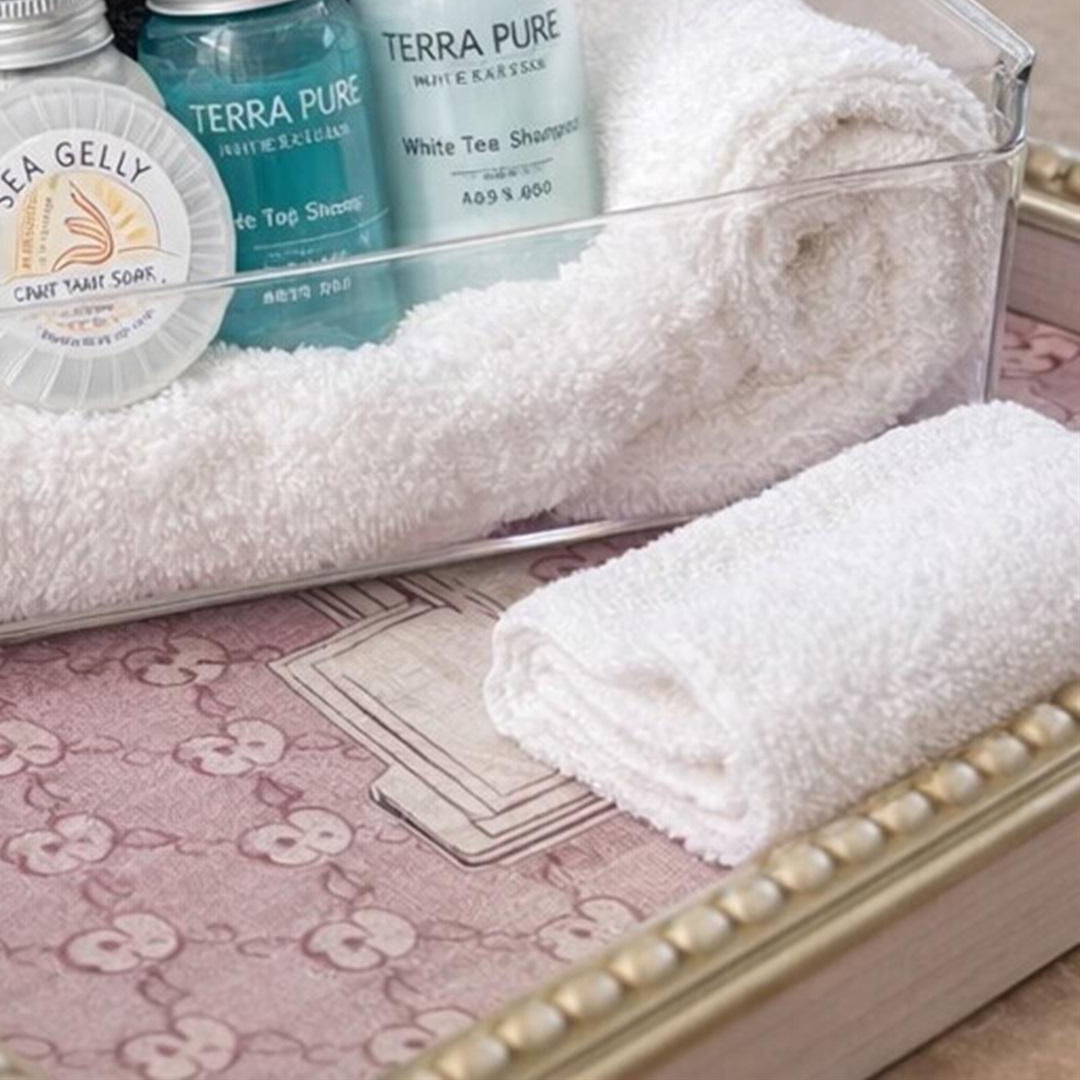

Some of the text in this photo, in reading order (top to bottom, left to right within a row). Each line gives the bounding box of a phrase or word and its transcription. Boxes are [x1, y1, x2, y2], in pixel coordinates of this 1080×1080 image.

[381, 8, 561, 62] TERRA PURE
[189, 74, 363, 134] TERRA PURE
[54, 140, 153, 183] GELLY
[402, 136, 456, 157] White
